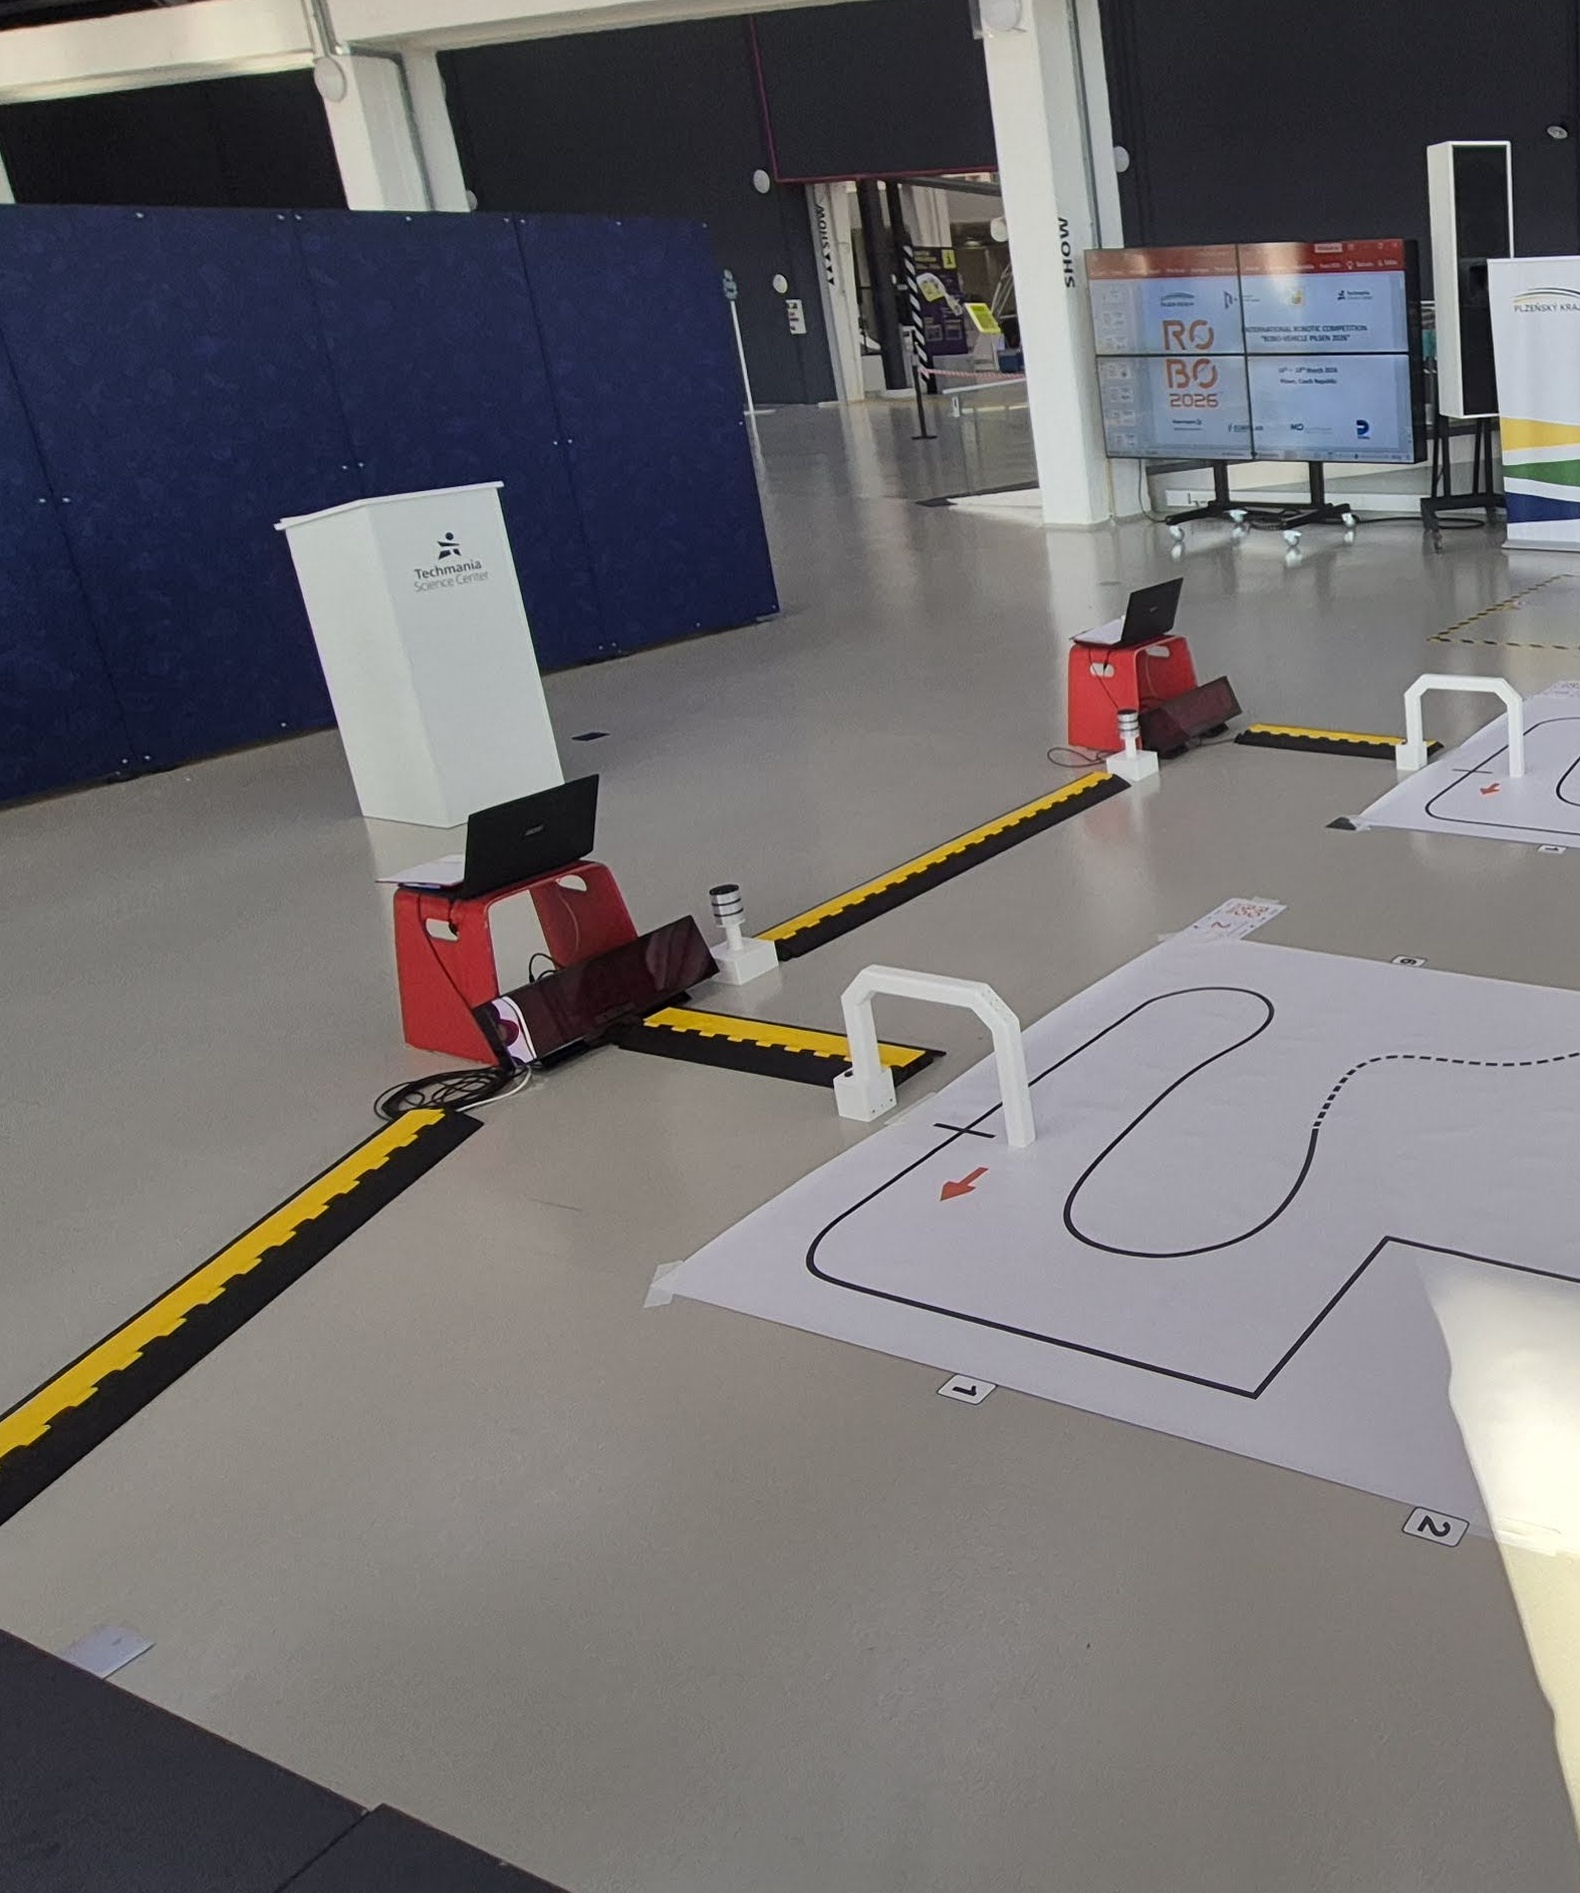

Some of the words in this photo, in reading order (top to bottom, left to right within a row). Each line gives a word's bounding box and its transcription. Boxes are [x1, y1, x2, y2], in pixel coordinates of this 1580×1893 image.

[1057, 216, 1076, 288] SHOW
[1513, 303, 1557, 313] PLZEŇSKÝ
[1162, 319, 1215, 350] RO
[1165, 358, 1218, 389] BO
[1169, 394, 1219, 408] 2026
[414, 559, 482, 579] Techmania
[413, 577, 455, 592] Science
[455, 571, 489, 585] Center
[952, 1385, 977, 1397] 1
[1417, 1515, 1451, 1537] 2
